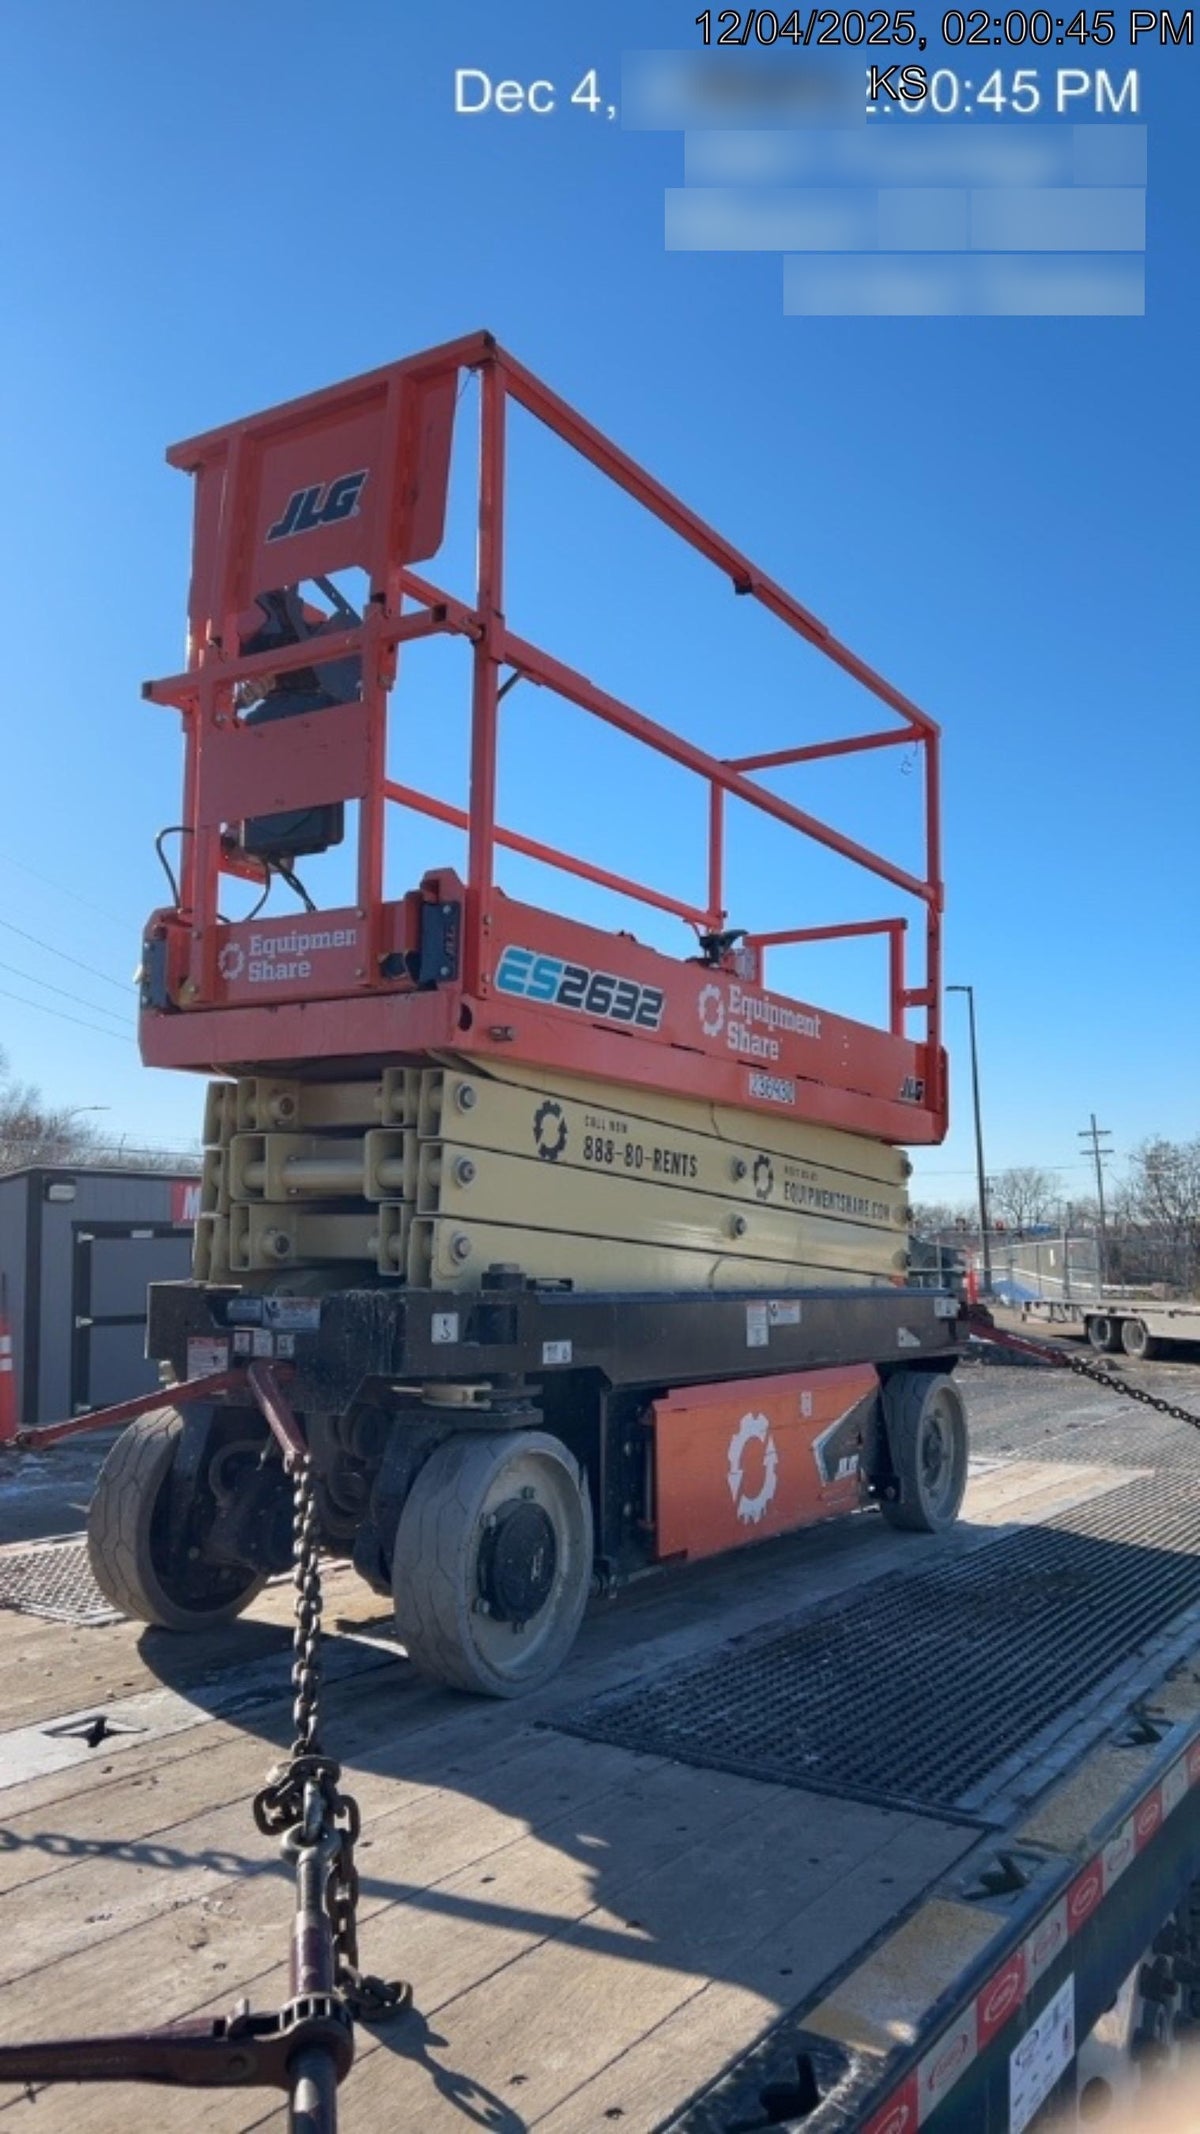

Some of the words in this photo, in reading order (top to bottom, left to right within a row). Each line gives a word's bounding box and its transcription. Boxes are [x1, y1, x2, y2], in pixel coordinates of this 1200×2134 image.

[265, 468, 369, 543] JLG
[249, 960, 311, 982] Share
[495, 945, 664, 1032] ES2632
[728, 985, 821, 1039] Equipment
[728, 1020, 779, 1060] Share
